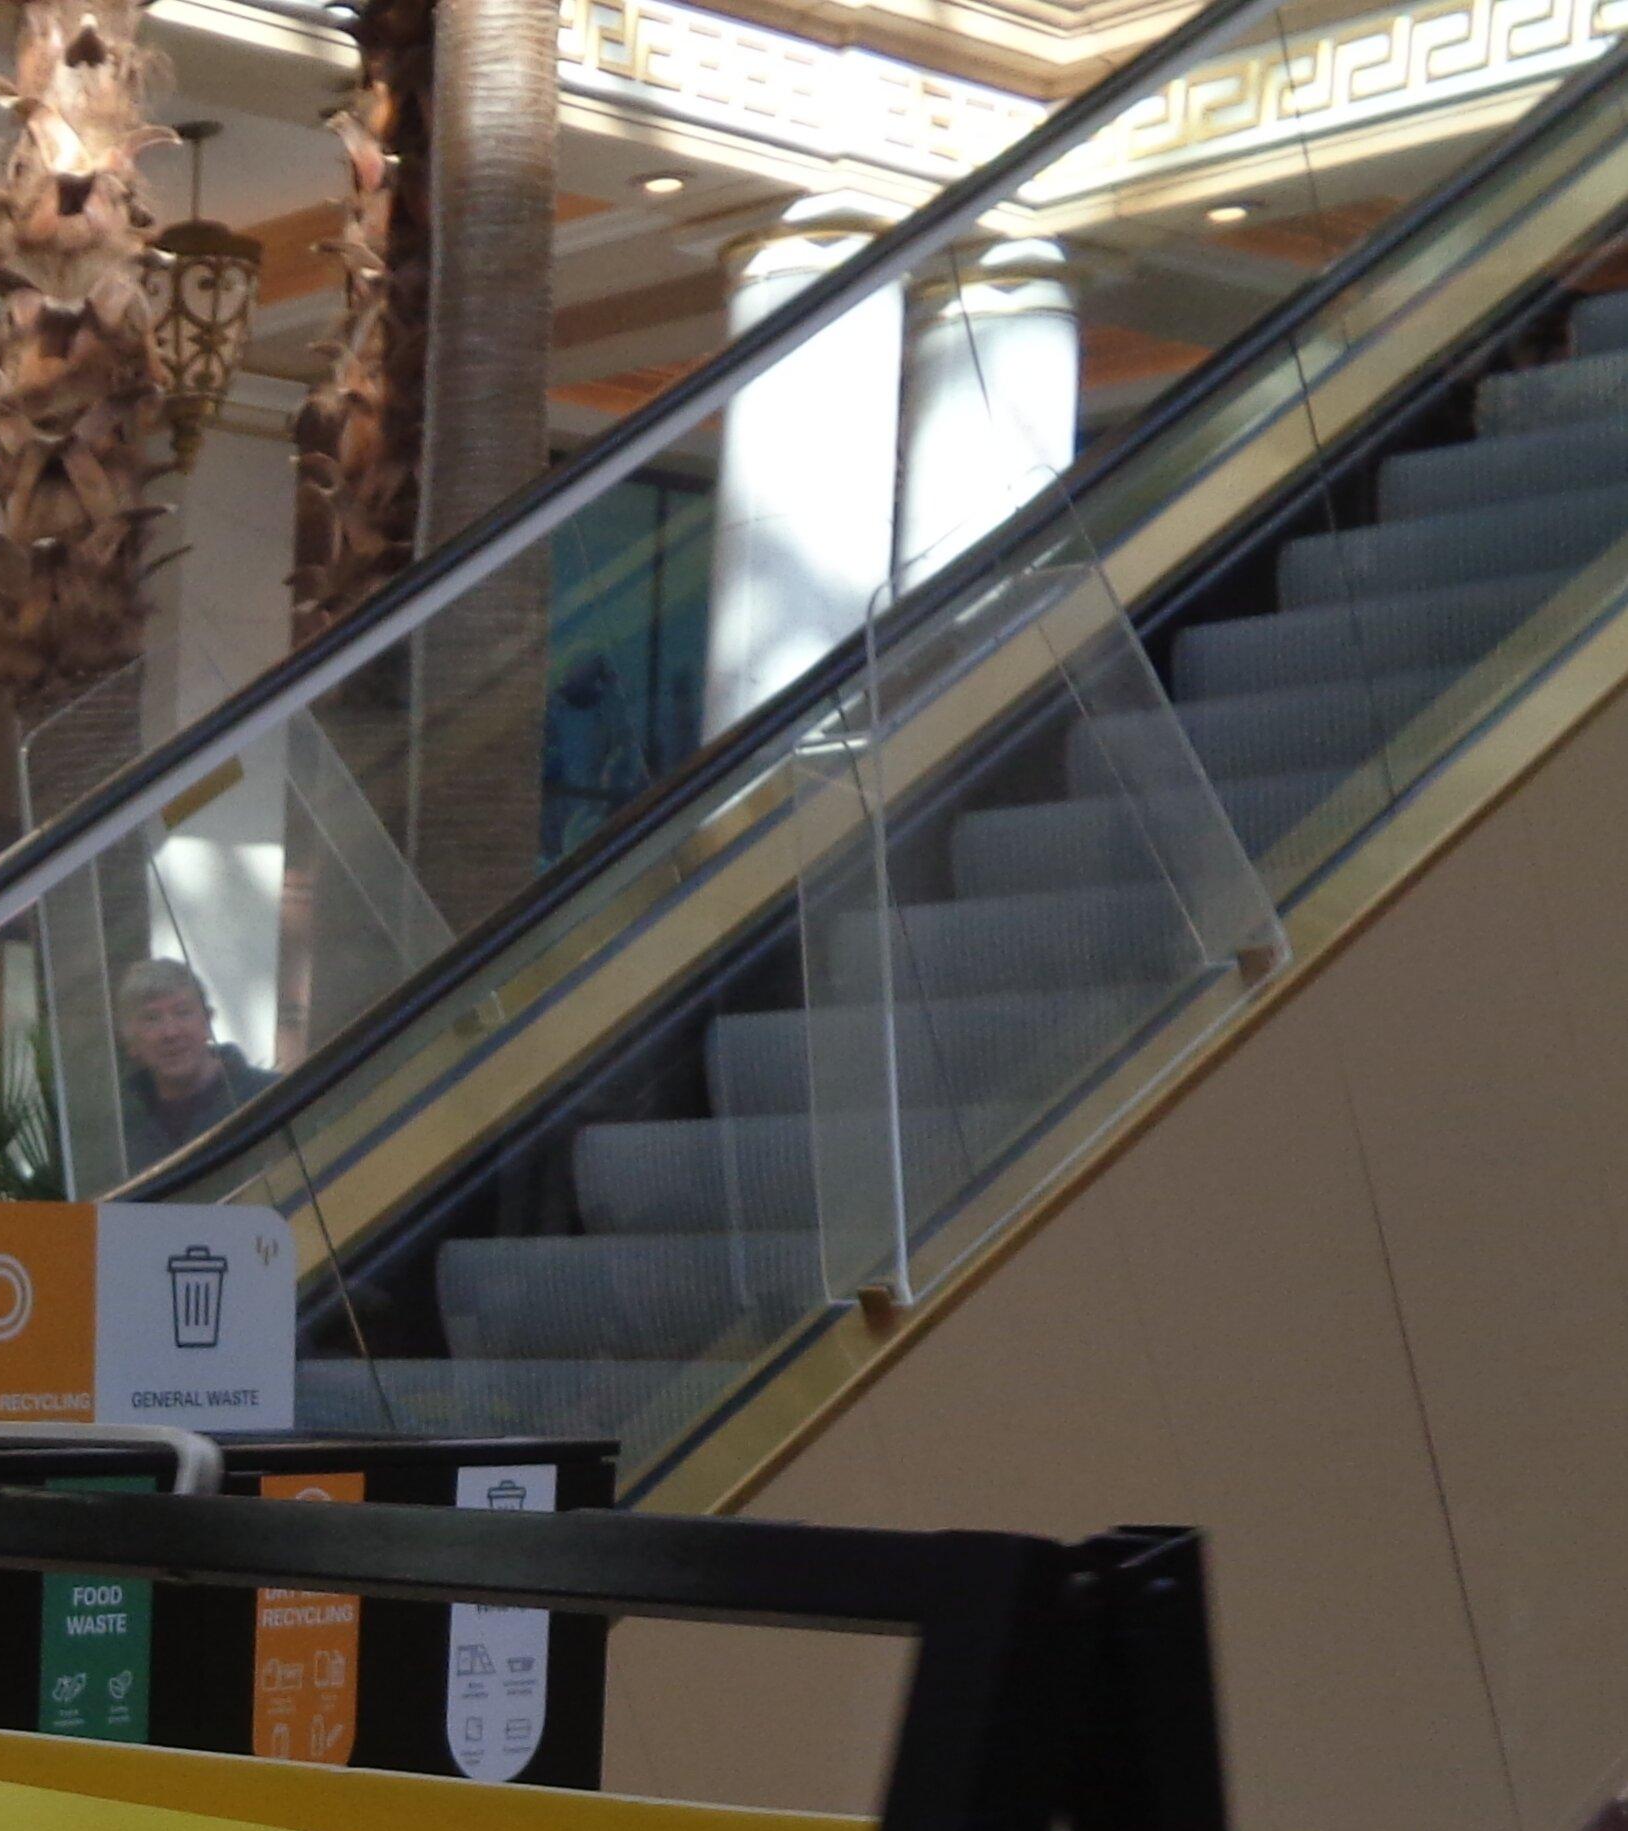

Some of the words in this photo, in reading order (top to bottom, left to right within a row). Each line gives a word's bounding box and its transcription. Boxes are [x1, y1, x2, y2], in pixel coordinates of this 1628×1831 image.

[0, 1392, 91, 1411] RECYCLING
[131, 1390, 202, 1408] GENERAL
[206, 1388, 260, 1407] WASTE
[73, 1585, 123, 1606] FOOD
[66, 1613, 128, 1635] WASTE
[261, 1604, 354, 1628] RECYCLING
